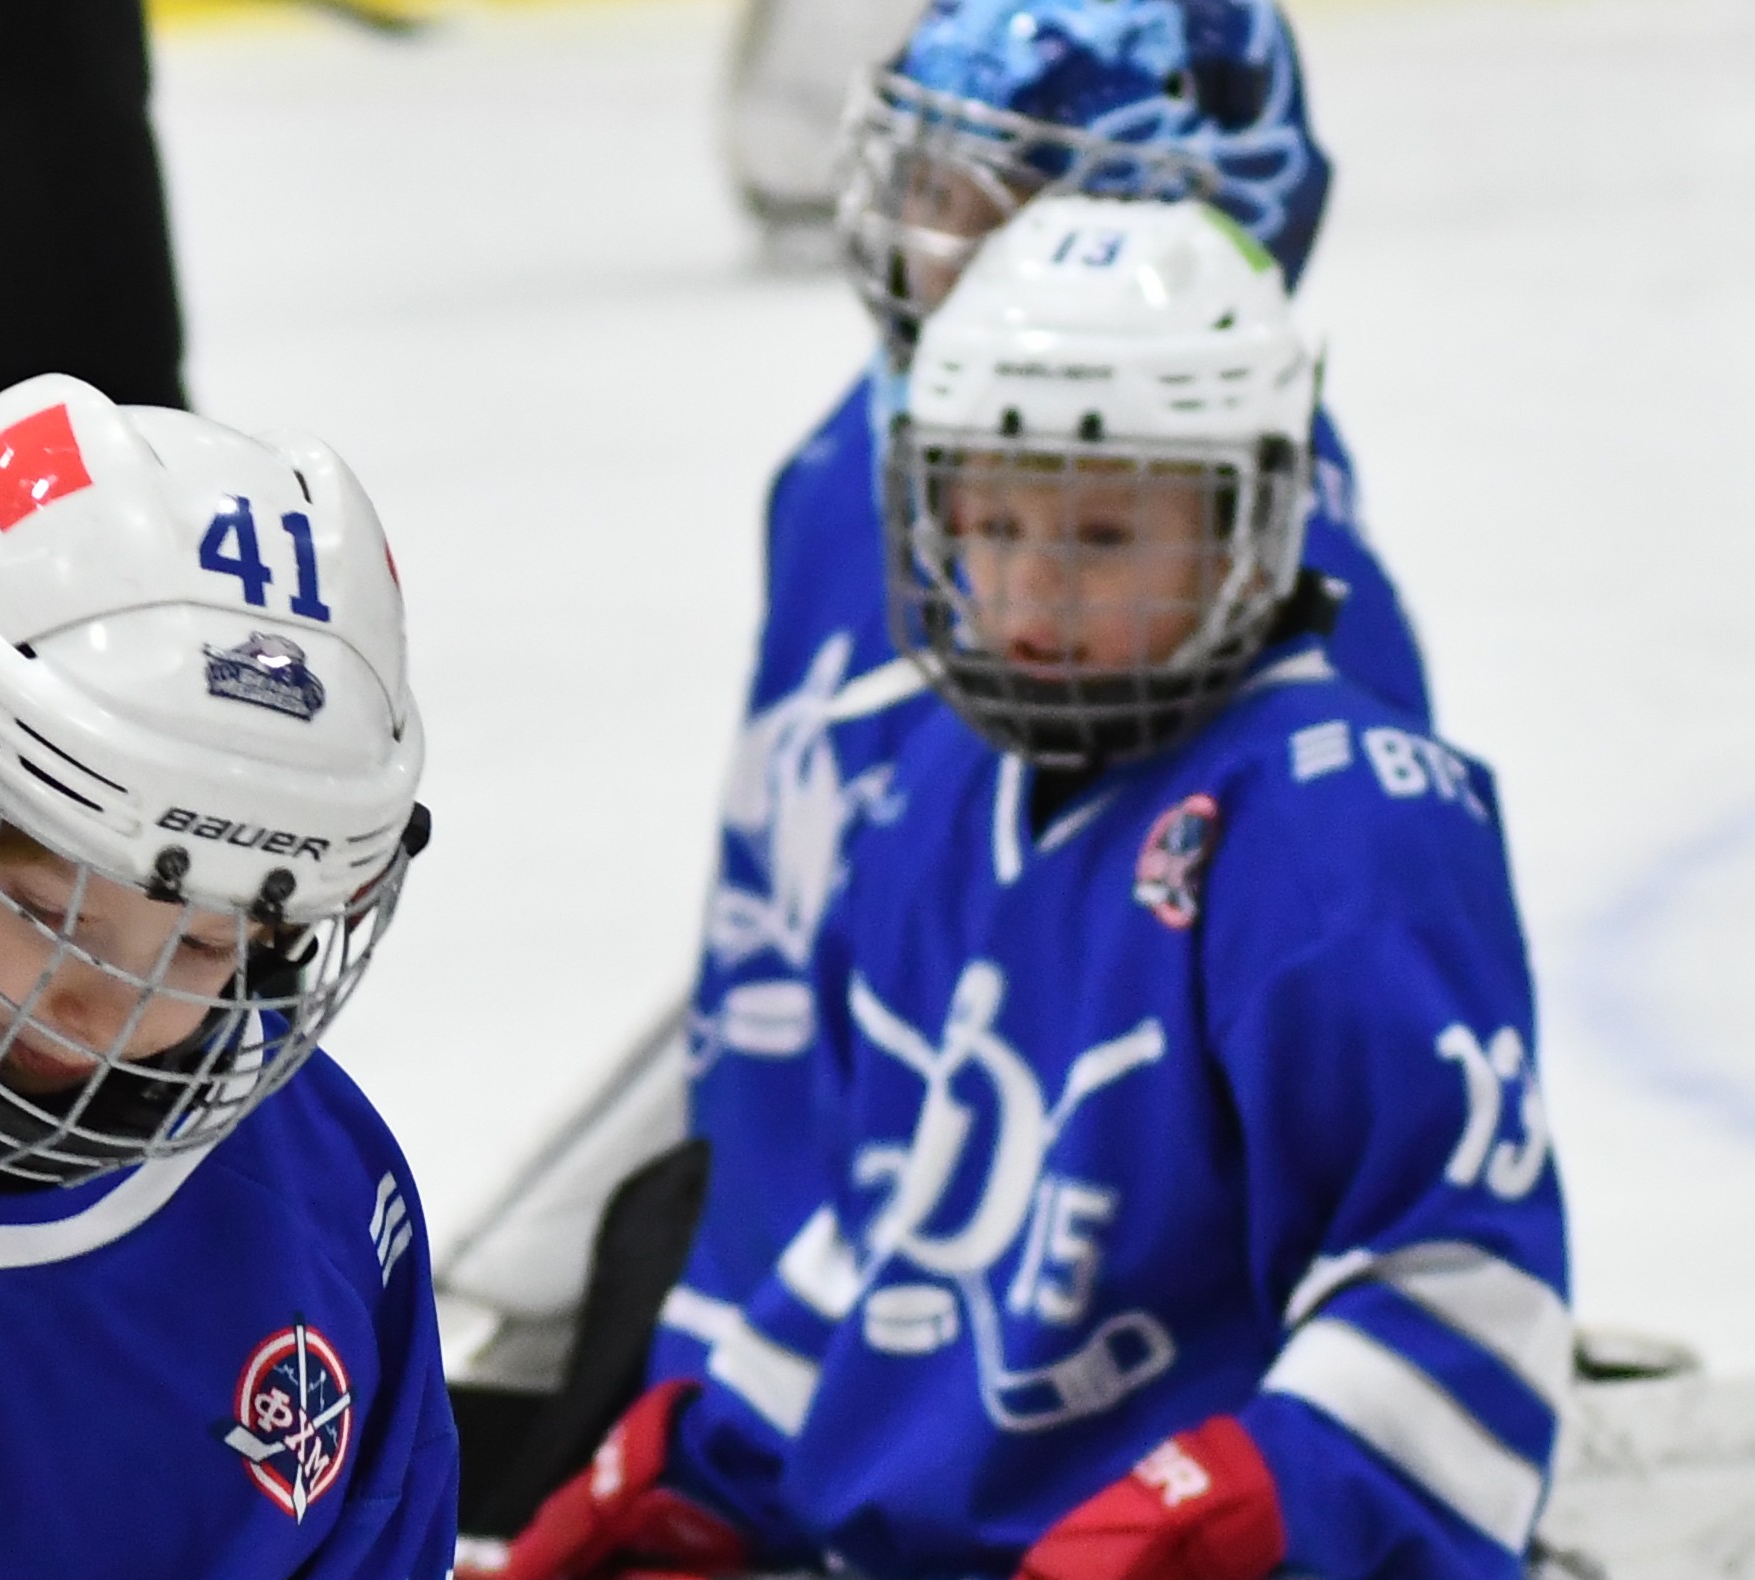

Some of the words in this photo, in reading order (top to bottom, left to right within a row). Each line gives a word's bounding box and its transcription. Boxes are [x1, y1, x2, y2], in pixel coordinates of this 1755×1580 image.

[198, 496, 331, 623] 41
[154, 807, 331, 862] BAUER
[254, 1387, 331, 1493] ФХМ
